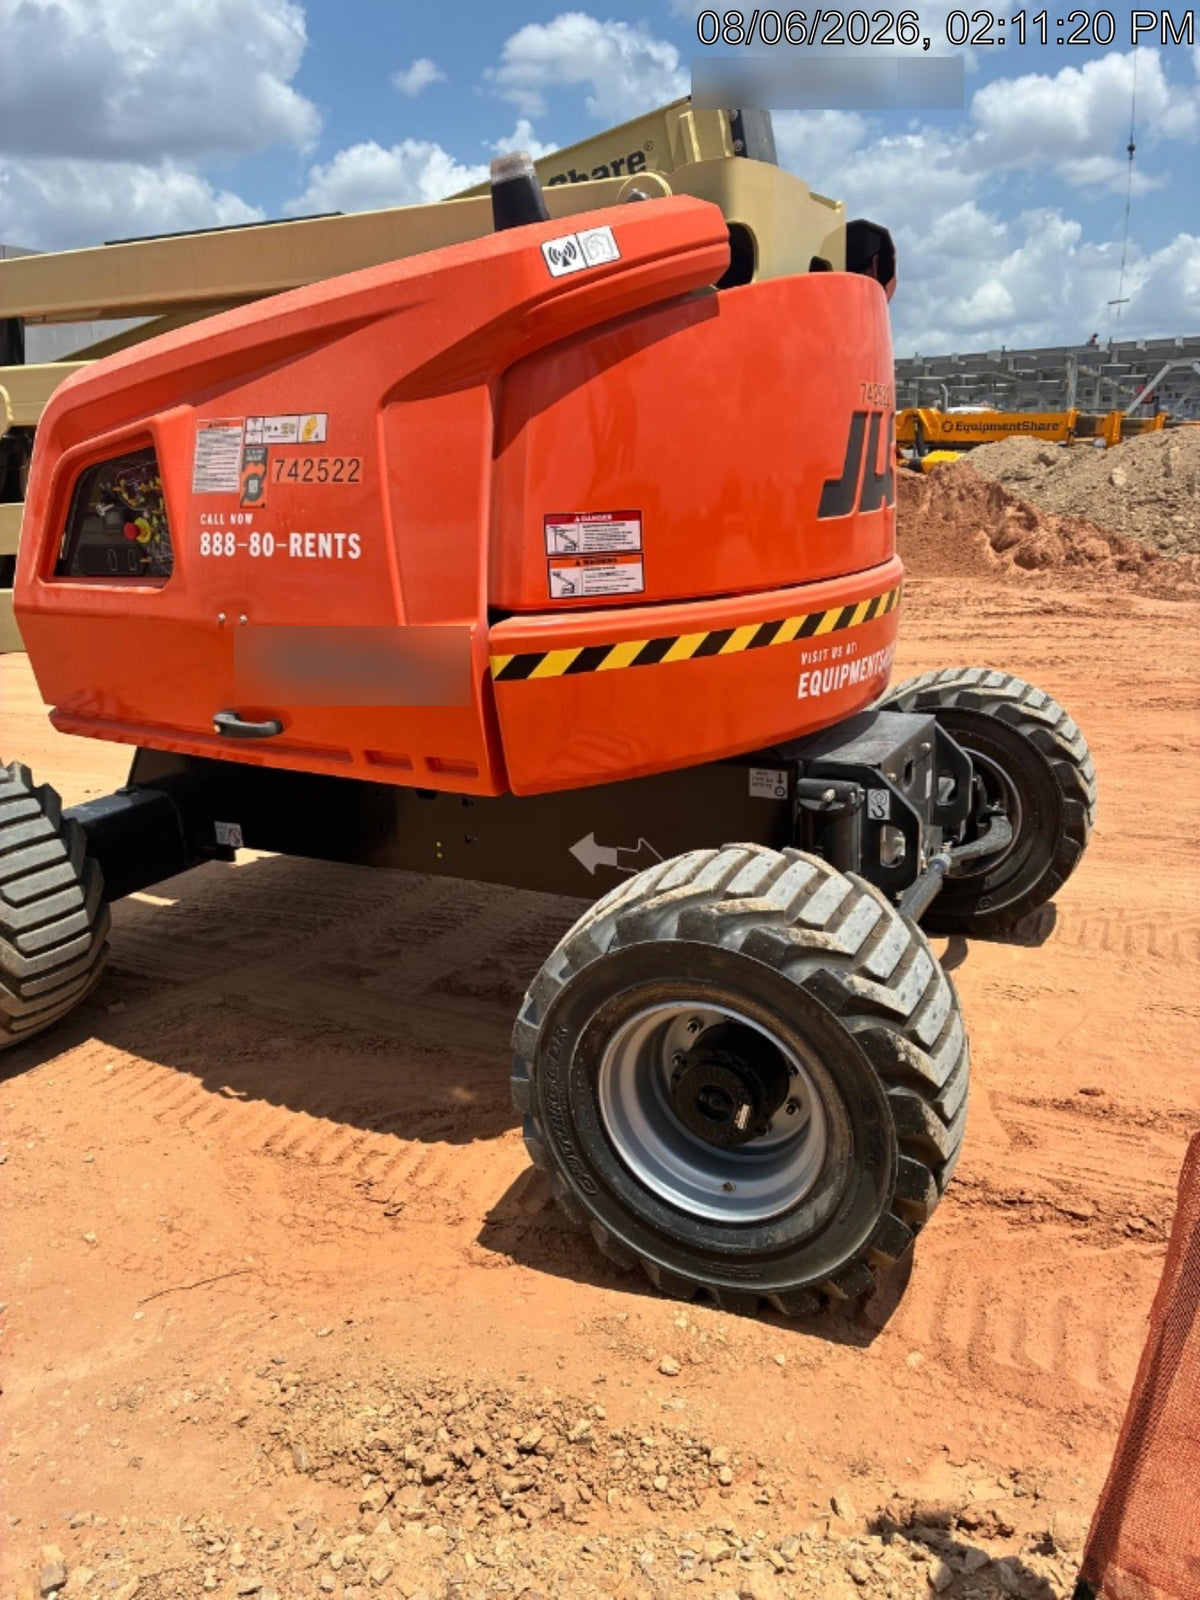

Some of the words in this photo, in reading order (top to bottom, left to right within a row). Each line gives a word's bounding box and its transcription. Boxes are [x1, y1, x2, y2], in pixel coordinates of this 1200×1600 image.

[955, 420, 1059, 433] EquipmentShare
[273, 457, 361, 483] 742522
[200, 513, 225, 525] CALL
[230, 513, 253, 525] NOW
[200, 532, 362, 560] 888-80-RENTS
[801, 648, 829, 665] VISIT
[831, 645, 844, 659] US
